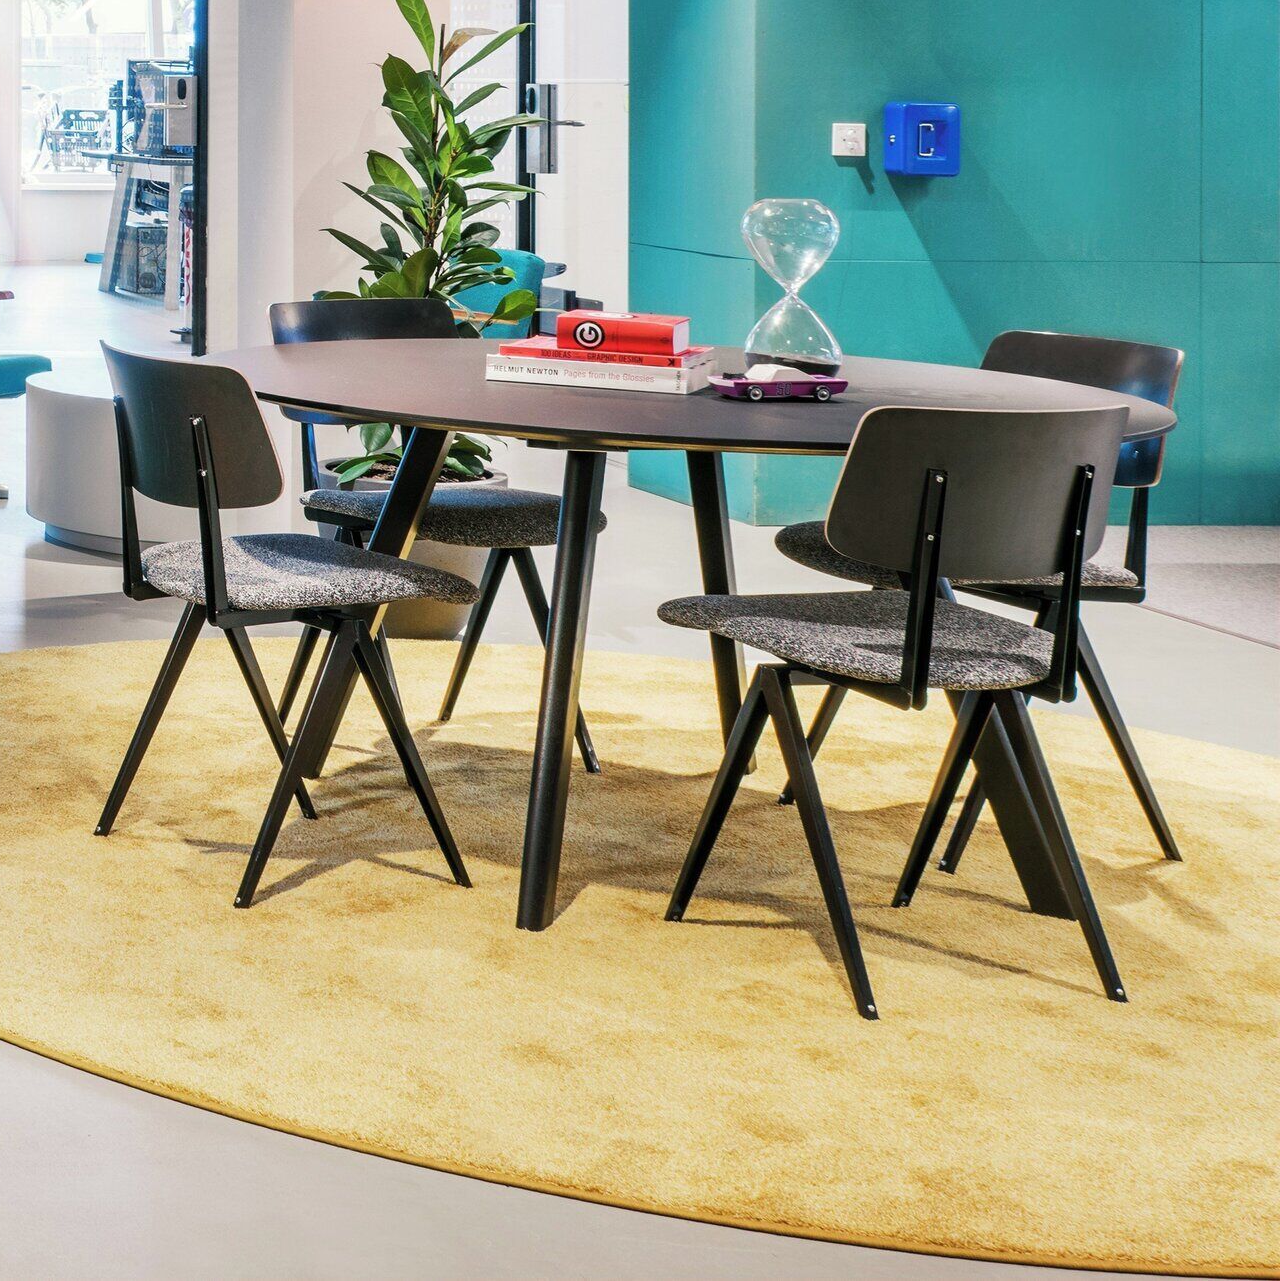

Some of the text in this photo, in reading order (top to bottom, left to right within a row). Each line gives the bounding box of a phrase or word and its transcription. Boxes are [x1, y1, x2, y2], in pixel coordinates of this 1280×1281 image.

[552, 350, 572, 359] IDEAS
[586, 352, 617, 363] GRAPHIC
[618, 354, 644, 364] DESIGN
[492, 364, 655, 383] HELMUT NEWTON Pages from the Glossies
